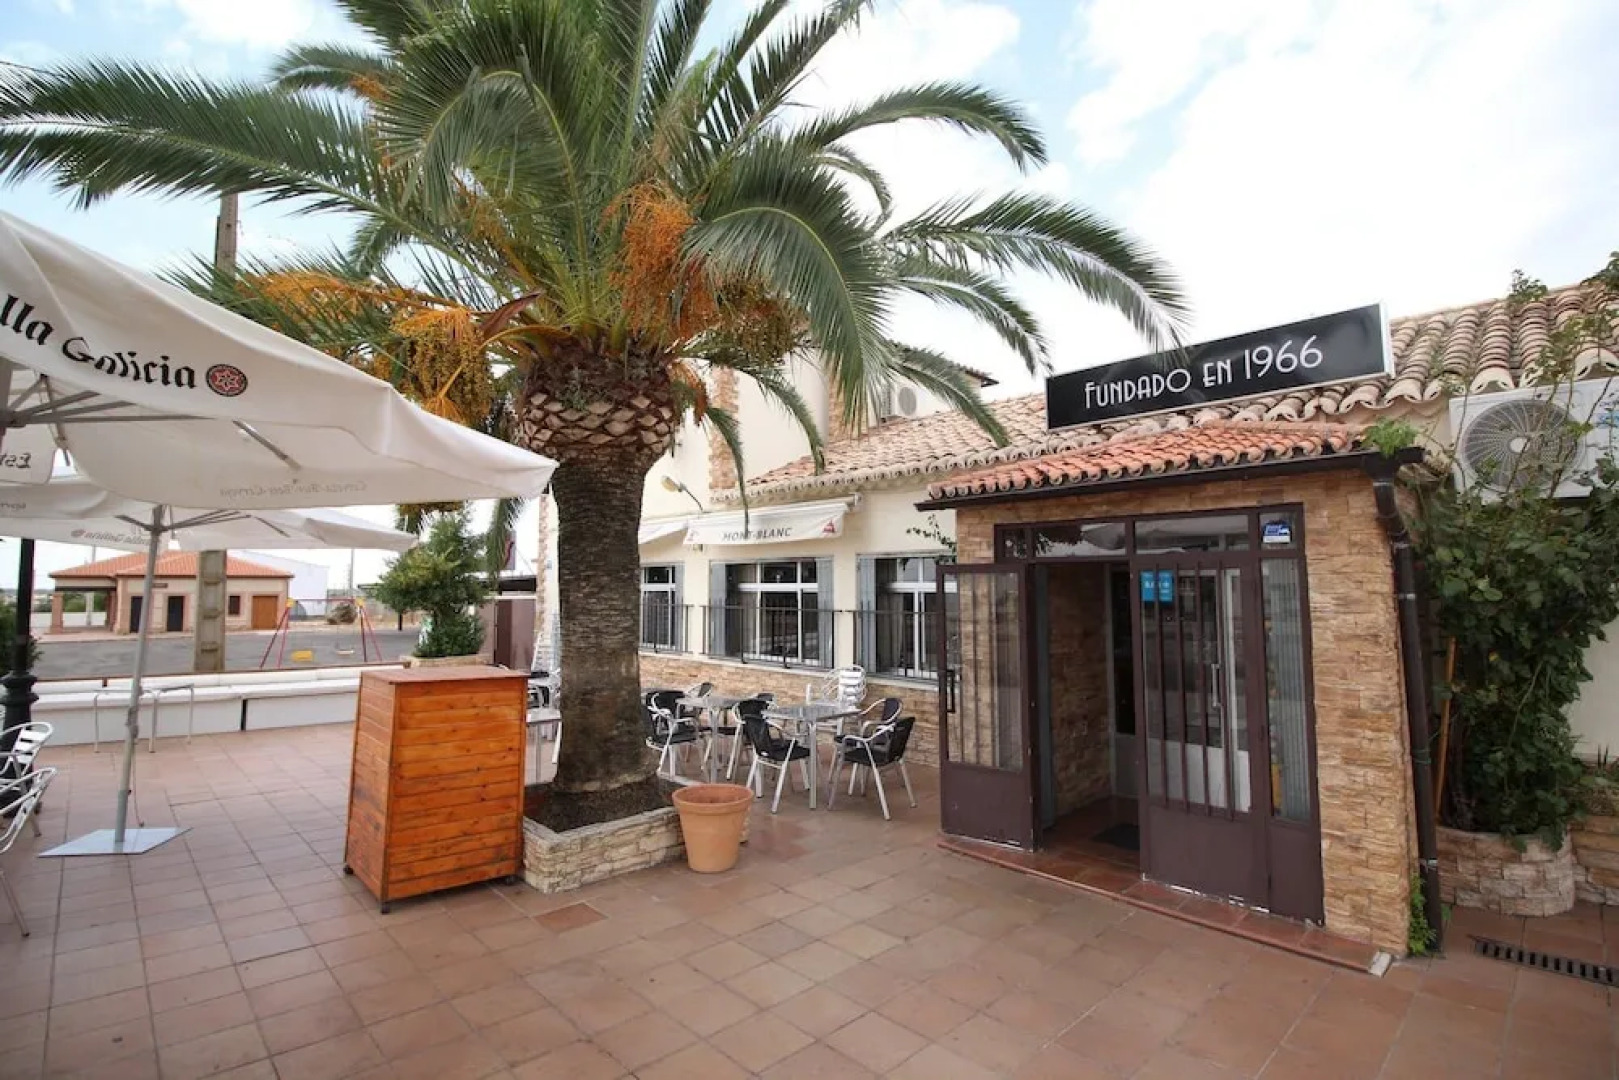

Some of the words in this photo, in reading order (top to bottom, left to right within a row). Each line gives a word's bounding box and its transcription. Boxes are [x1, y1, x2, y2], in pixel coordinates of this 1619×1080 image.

[62, 336, 197, 389] Galicia
[1085, 368, 1191, 409] FUNDADO
[1203, 358, 1233, 387] EN
[1244, 334, 1323, 381] 1966
[721, 527, 793, 542] MONT-BLANC
